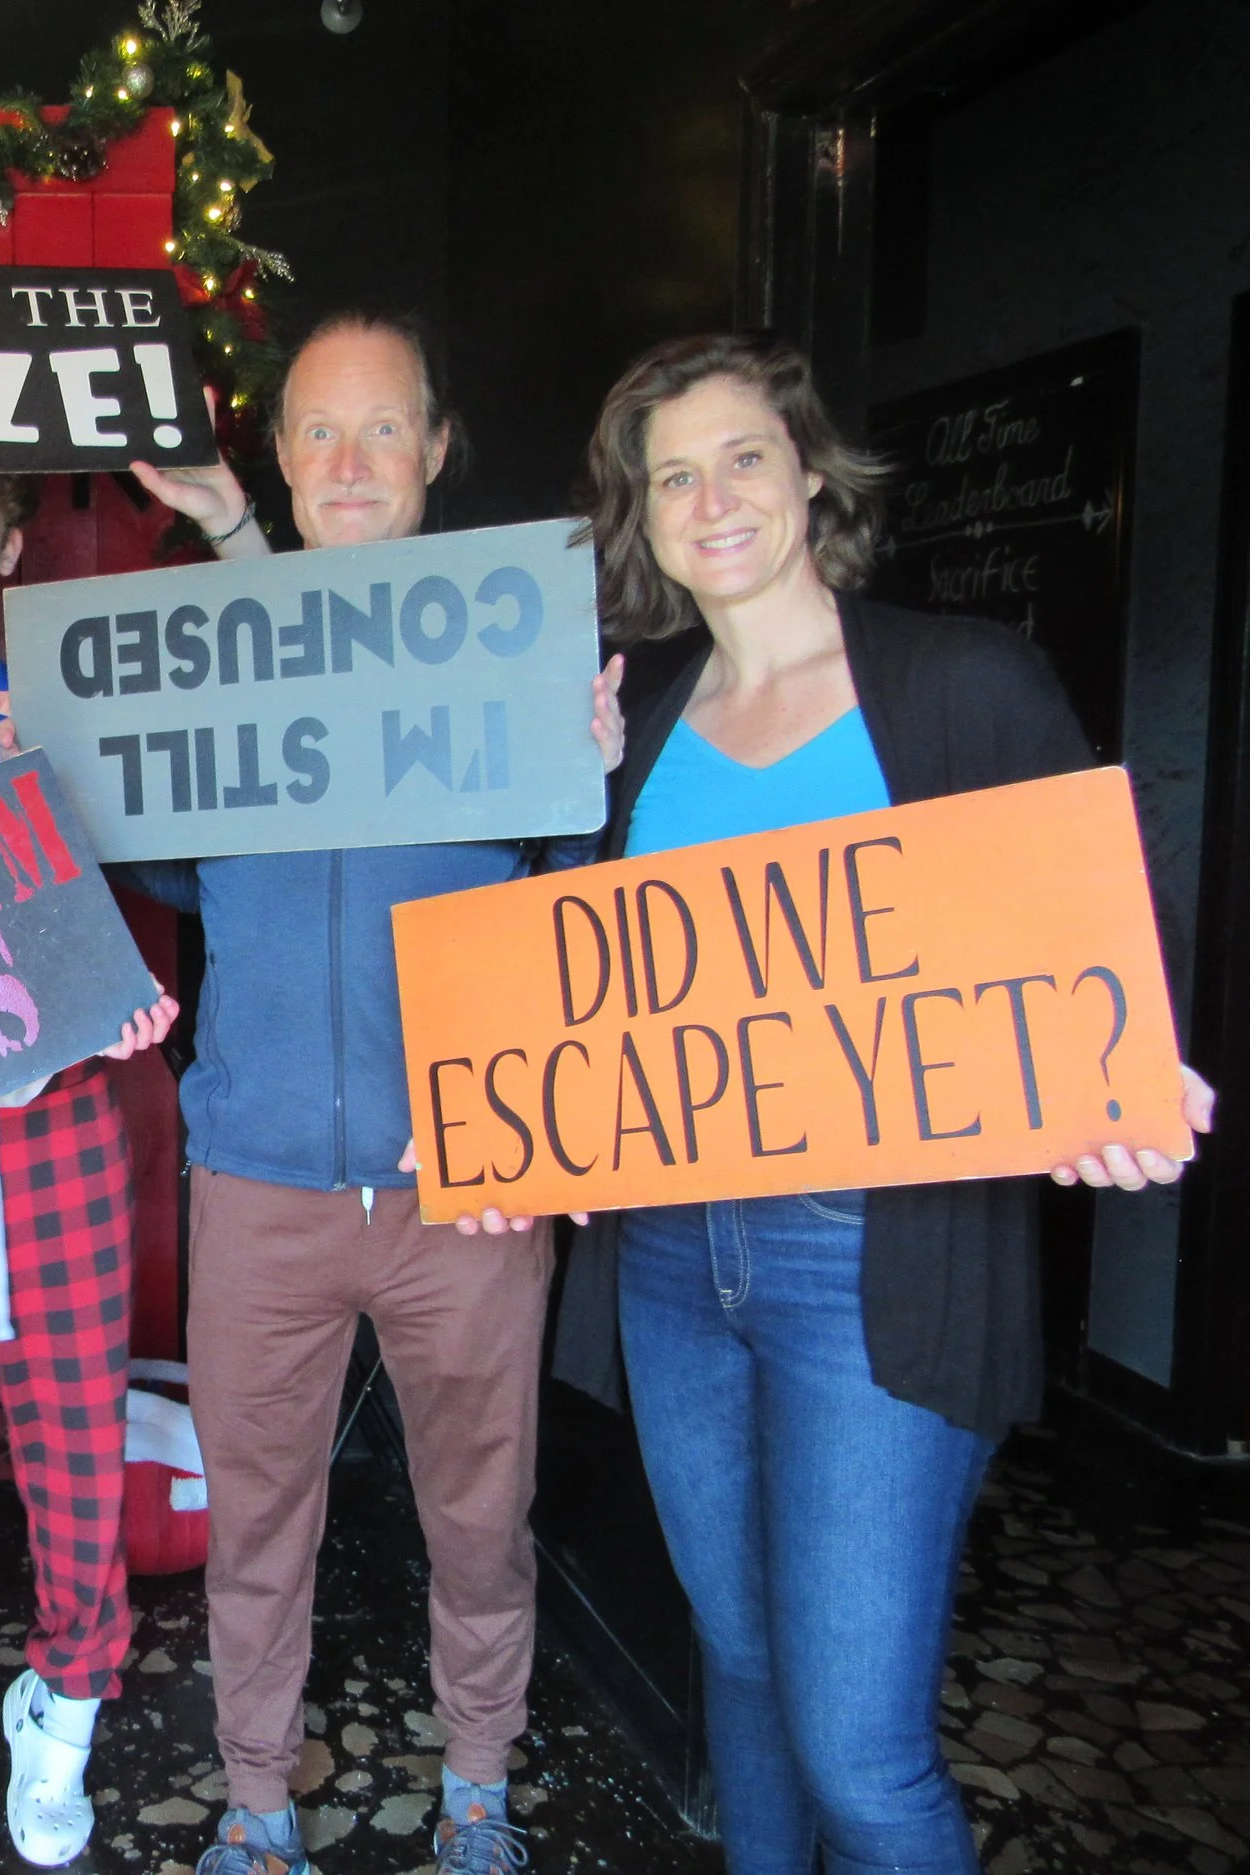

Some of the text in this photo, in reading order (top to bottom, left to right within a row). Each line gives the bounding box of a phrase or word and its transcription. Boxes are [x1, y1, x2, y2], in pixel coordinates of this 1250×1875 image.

[12, 287, 162, 328] THE
[901, 441, 1077, 532] Leaderboard
[926, 397, 1041, 467] All Time
[60, 566, 543, 698] CONFUSED
[99, 701, 510, 816] I'M STILL
[552, 836, 919, 1028] DID WE
[429, 965, 1128, 1190] ESCAPE YET?
